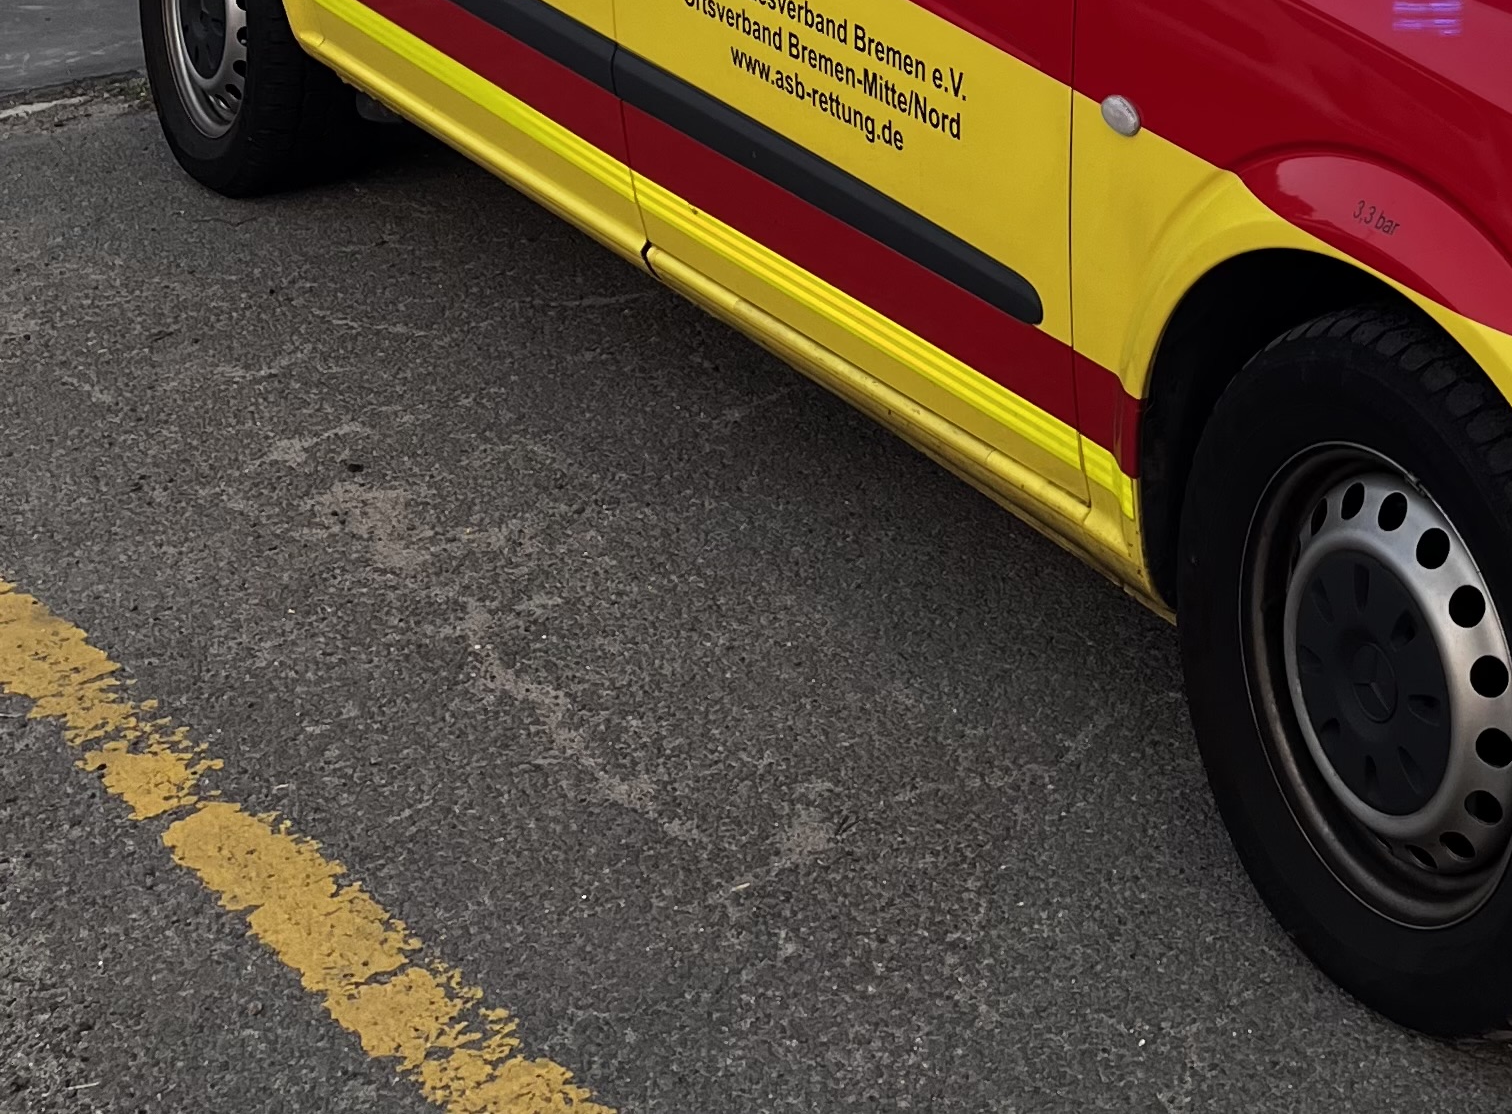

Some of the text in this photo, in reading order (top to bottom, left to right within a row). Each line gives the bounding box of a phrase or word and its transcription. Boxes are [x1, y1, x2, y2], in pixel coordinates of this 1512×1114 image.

[730, 46, 905, 151] www.asb-rettung.de
[788, 32, 962, 140] Bremen-Mitte/Nord
[854, 23, 926, 82] Bremen
[932, 66, 967, 102] e.V.
[1375, 210, 1401, 236] bar
